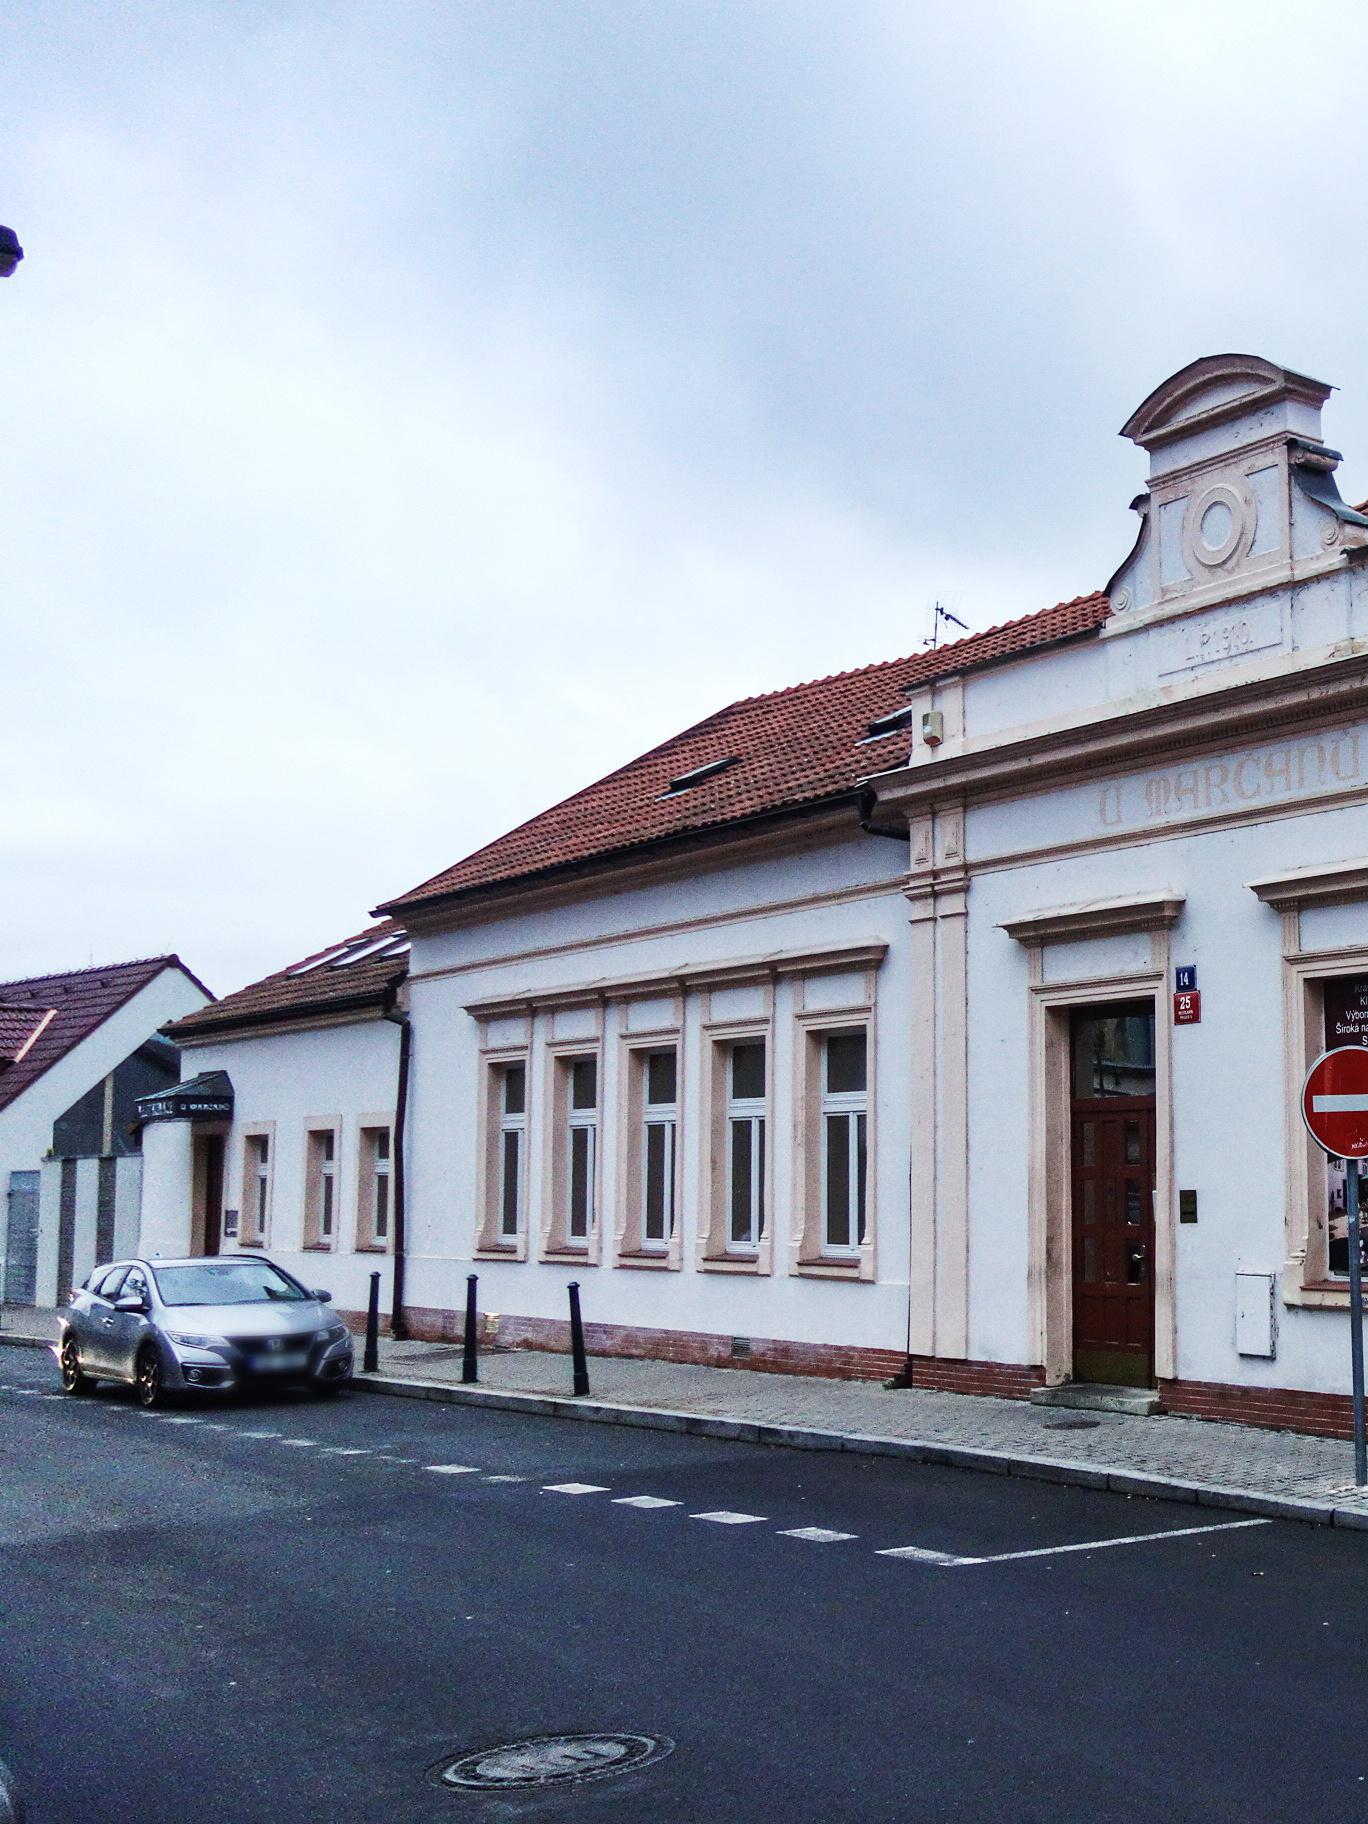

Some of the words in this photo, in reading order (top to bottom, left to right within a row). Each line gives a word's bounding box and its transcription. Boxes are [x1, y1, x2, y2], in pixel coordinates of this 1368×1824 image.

[1099, 783, 1122, 827] U
[1180, 972, 1189, 986] 14
[1180, 996, 1191, 1010] 25
[1335, 1022, 1359, 1035] Široká
